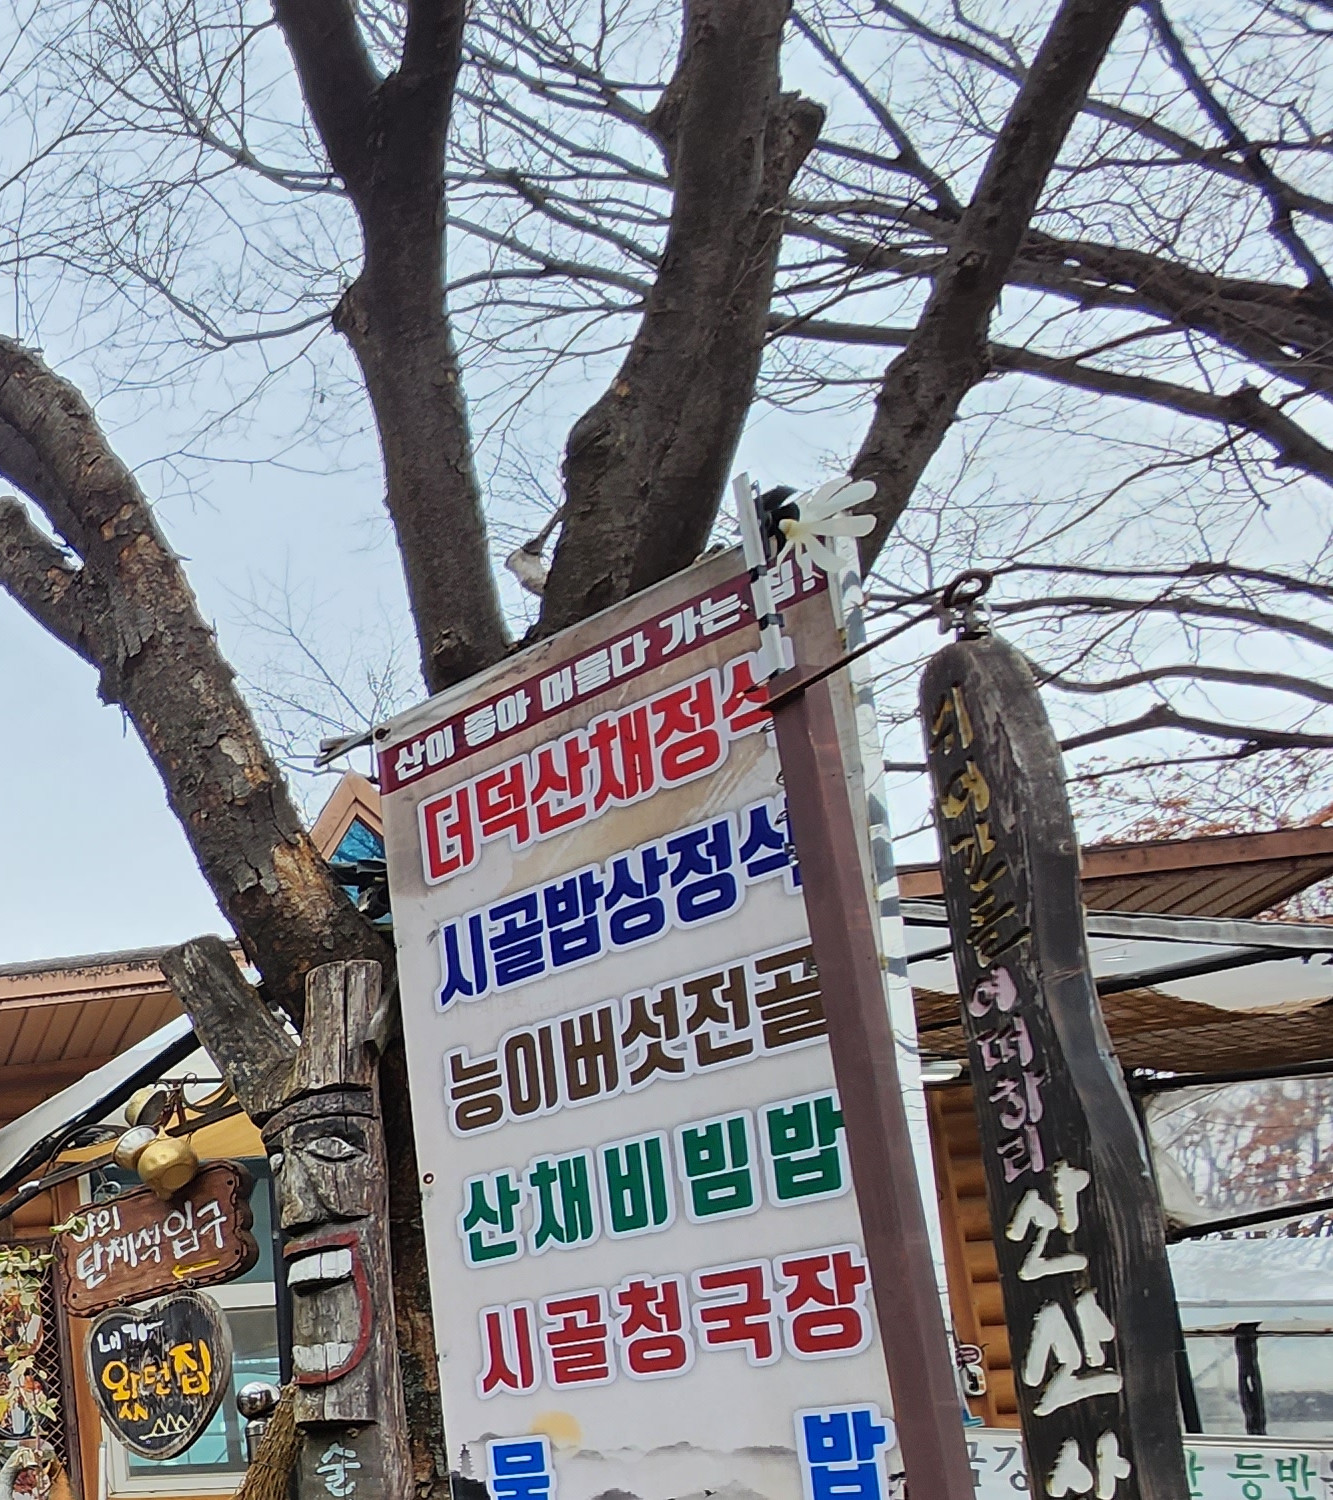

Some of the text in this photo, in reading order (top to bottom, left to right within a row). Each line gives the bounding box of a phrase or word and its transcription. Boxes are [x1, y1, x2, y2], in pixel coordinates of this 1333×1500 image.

[394, 724, 455, 782] 산이
[463, 693, 530, 748] 좋아
[539, 636, 650, 712] 머물다
[660, 591, 742, 655] 가는
[449, 943, 829, 1132] 능이버섯전골
[464, 1096, 845, 1262] 산채비빔밥
[97, 1320, 165, 1353] 내가
[483, 1250, 867, 1393] 시골청국장
